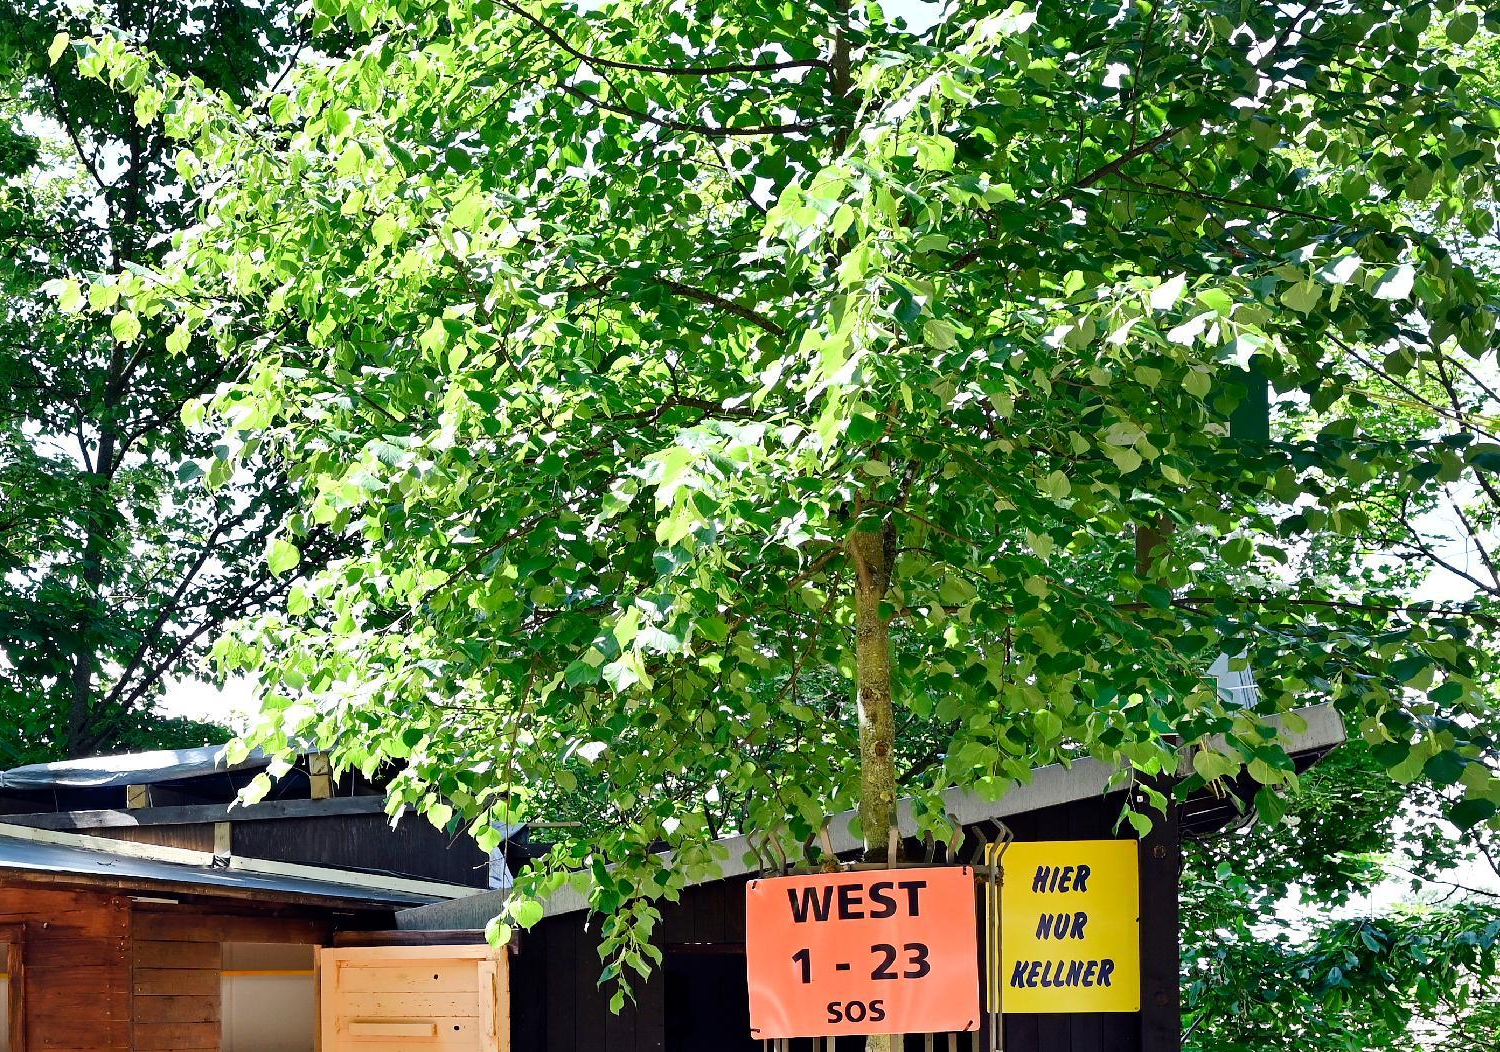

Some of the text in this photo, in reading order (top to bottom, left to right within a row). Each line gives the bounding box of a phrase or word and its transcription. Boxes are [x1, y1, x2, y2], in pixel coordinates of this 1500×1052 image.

[1031, 865, 1091, 893] HIER
[787, 880, 927, 923] WEST
[1035, 912, 1087, 940] NUR
[791, 948, 812, 983] 1
[870, 943, 931, 980] 23
[1010, 959, 1114, 988] KELLNER
[827, 1000, 885, 1024] SOS
